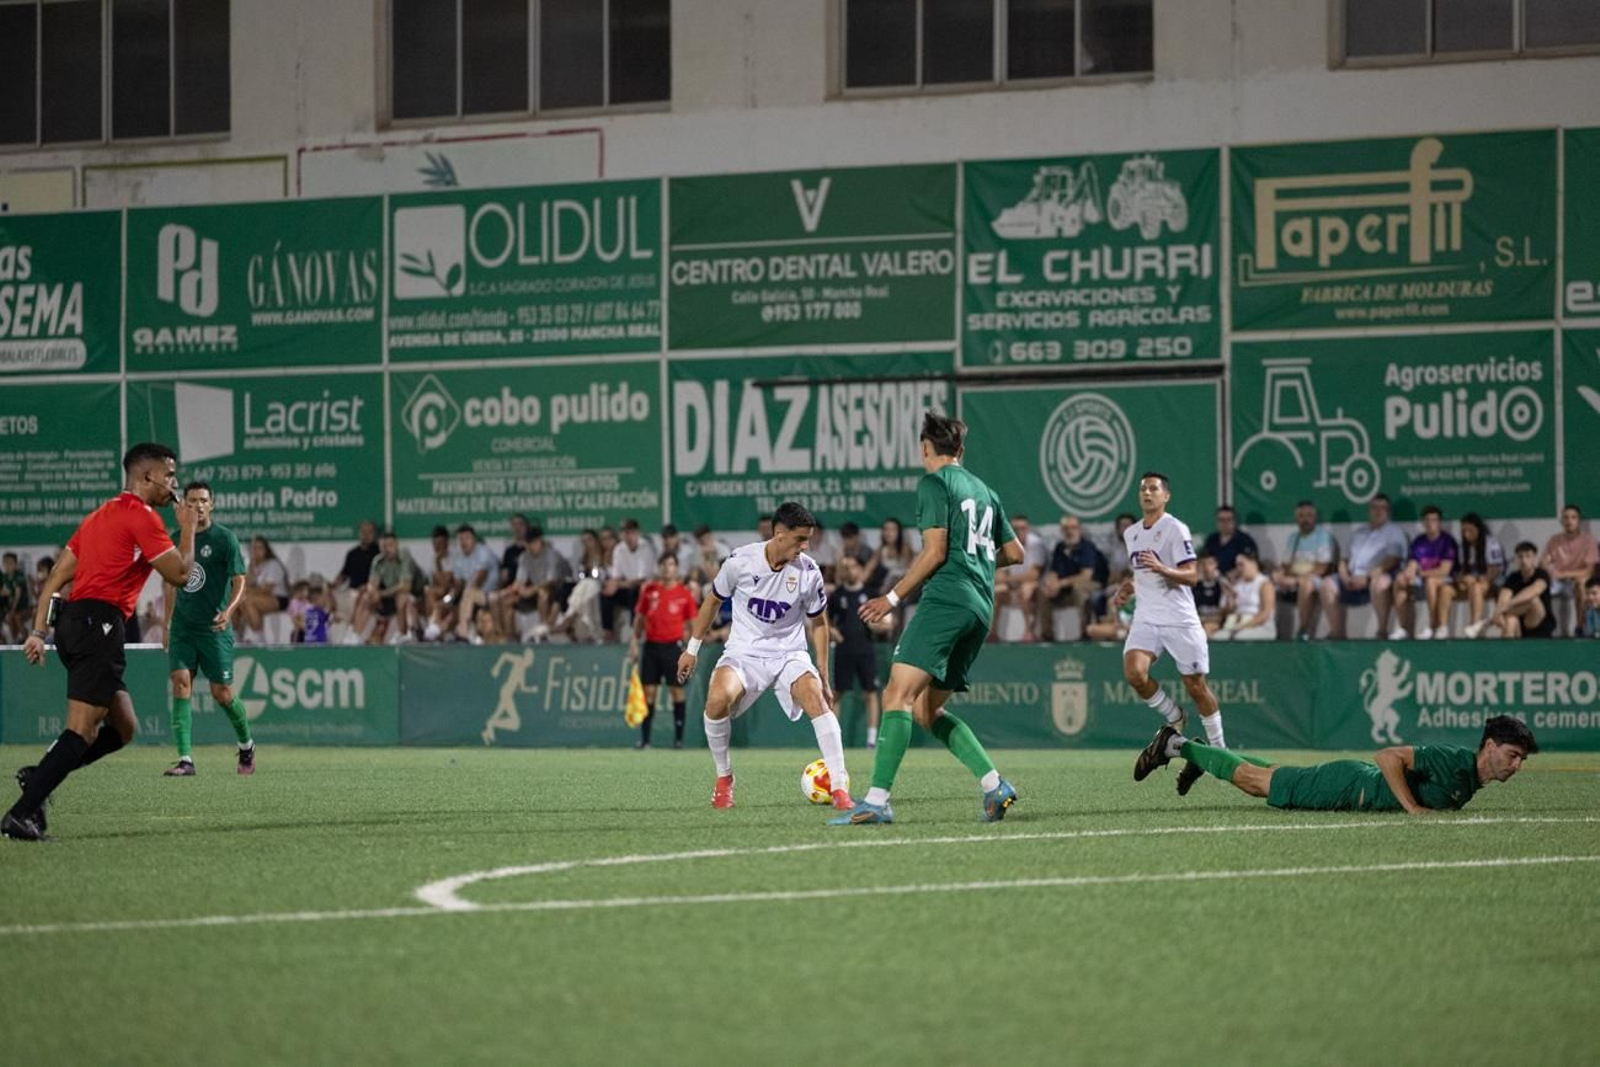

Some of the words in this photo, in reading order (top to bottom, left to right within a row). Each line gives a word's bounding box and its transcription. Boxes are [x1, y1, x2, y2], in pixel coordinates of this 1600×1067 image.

[469, 195, 653, 268] OLIDUL
[967, 249, 1024, 283] EL
[1042, 243, 1212, 284] CHURRI
[1494, 236, 1548, 267] S.L.
[671, 257, 764, 286] CENTRO
[768, 253, 857, 282] DENTAL
[862, 249, 954, 277] VALERO
[609, 276, 624, 290] DE
[864, 284, 889, 299] Real
[1372, 284, 1398, 301] DE
[1399, 280, 1494, 300] MOLDURAS
[995, 286, 1157, 308] EXCAVACIONES
[1166, 285, 1181, 303] Y
[967, 310, 1081, 330] SERVICIOS
[132, 326, 238, 345] GAMEZ
[391, 333, 440, 348] AVENIDA
[442, 331, 459, 346] DE
[570, 325, 626, 340] MANCHA
[628, 323, 659, 338] REAL
[1009, 341, 1062, 361] 663
[1073, 338, 1126, 360] 309
[1136, 336, 1192, 358] 250
[1384, 355, 1543, 392] Agroservicios
[244, 390, 364, 435] Lacrist
[463, 386, 541, 427] cobo
[550, 381, 650, 434] pulido
[312, 434, 365, 448] cristales
[491, 436, 556, 453] COMERCIAL
[269, 464, 291, 479] 953
[280, 486, 338, 509] Pedro
[432, 479, 506, 495] PAVIMENTOS
[517, 475, 620, 494] REVESTIMIENTOS
[746, 480, 767, 496] DEL
[770, 478, 822, 495] CARMEN,
[849, 477, 902, 492] MANCHA
[396, 498, 468, 514] MATERIALES
[470, 497, 486, 513] DE
[575, 487, 659, 511] CALEFACCIÓN
[960, 498, 995, 561] 14
[271, 668, 365, 709] scm
[1415, 671, 1600, 705] MORTERO
